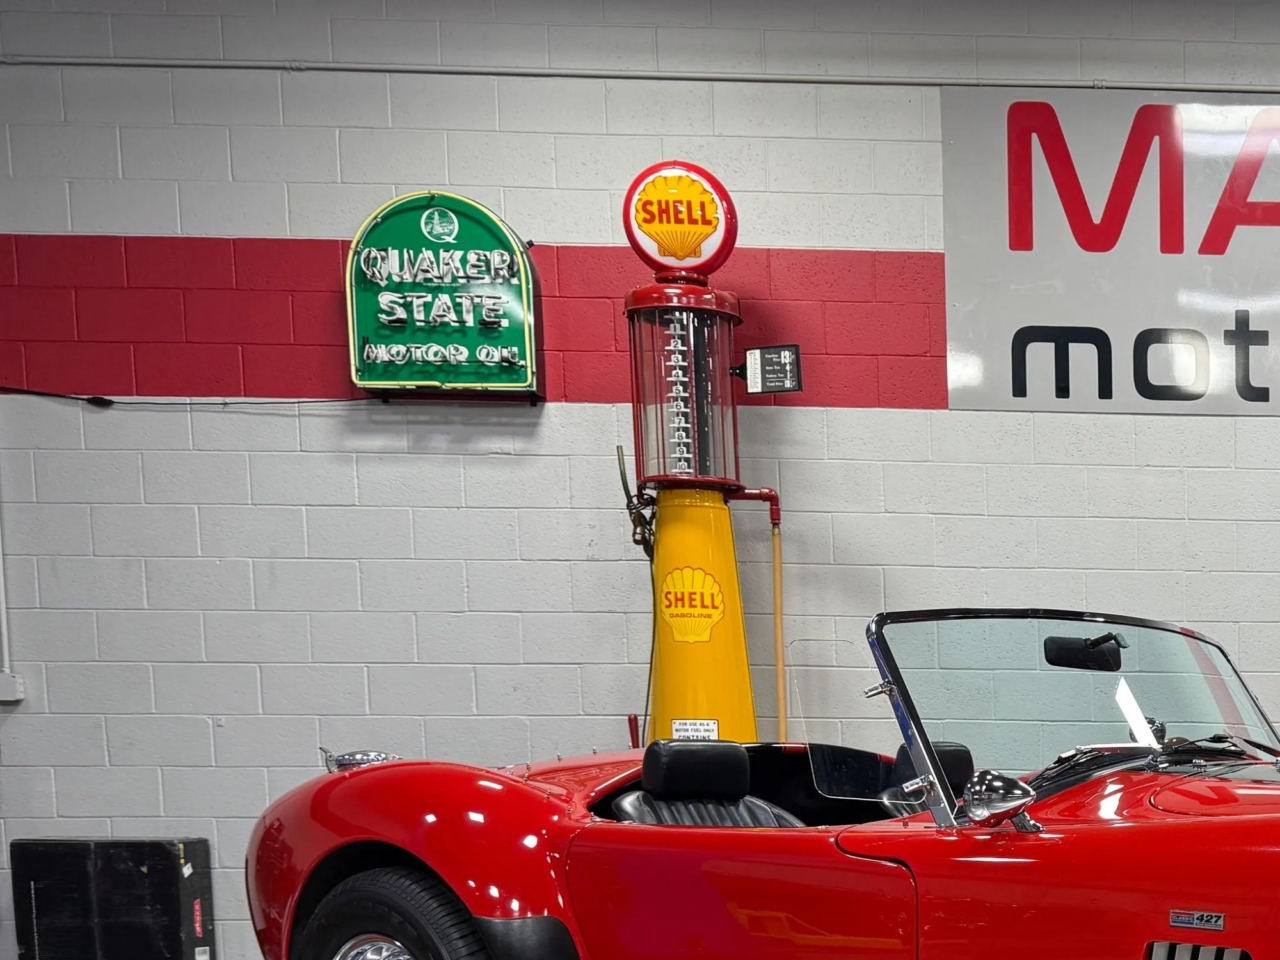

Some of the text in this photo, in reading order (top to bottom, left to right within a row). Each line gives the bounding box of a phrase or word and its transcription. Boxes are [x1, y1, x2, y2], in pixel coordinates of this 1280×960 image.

[641, 200, 713, 226] SHELL
[361, 247, 520, 287] QUAKER
[378, 292, 509, 328] STATE
[363, 342, 527, 367] MOTOR OIL
[664, 591, 719, 610] SHELL
[1196, 914, 1222, 923] 427
